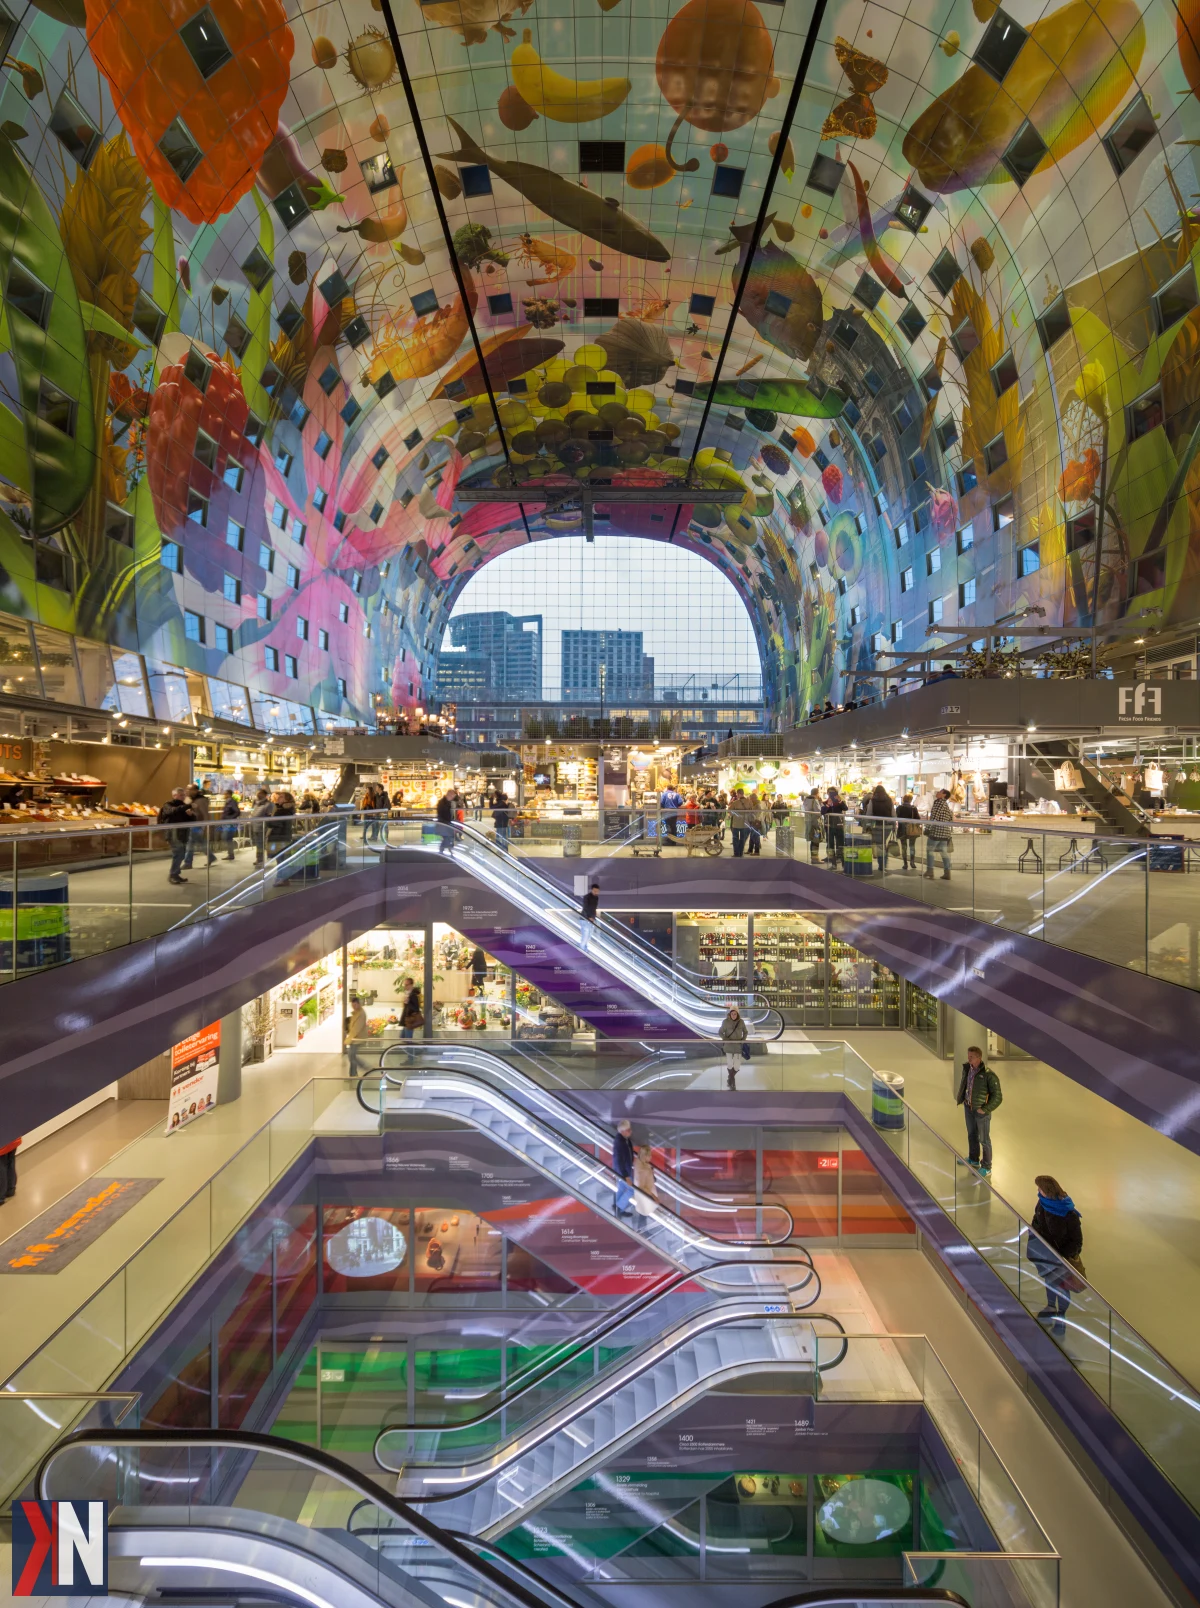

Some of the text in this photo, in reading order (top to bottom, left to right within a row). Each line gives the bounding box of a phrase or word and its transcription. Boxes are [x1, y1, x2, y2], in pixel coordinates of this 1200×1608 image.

[43, 1181, 122, 1241] vendor
[678, 1434, 694, 1442] 1400
[615, 1475, 631, 1483] 1329
